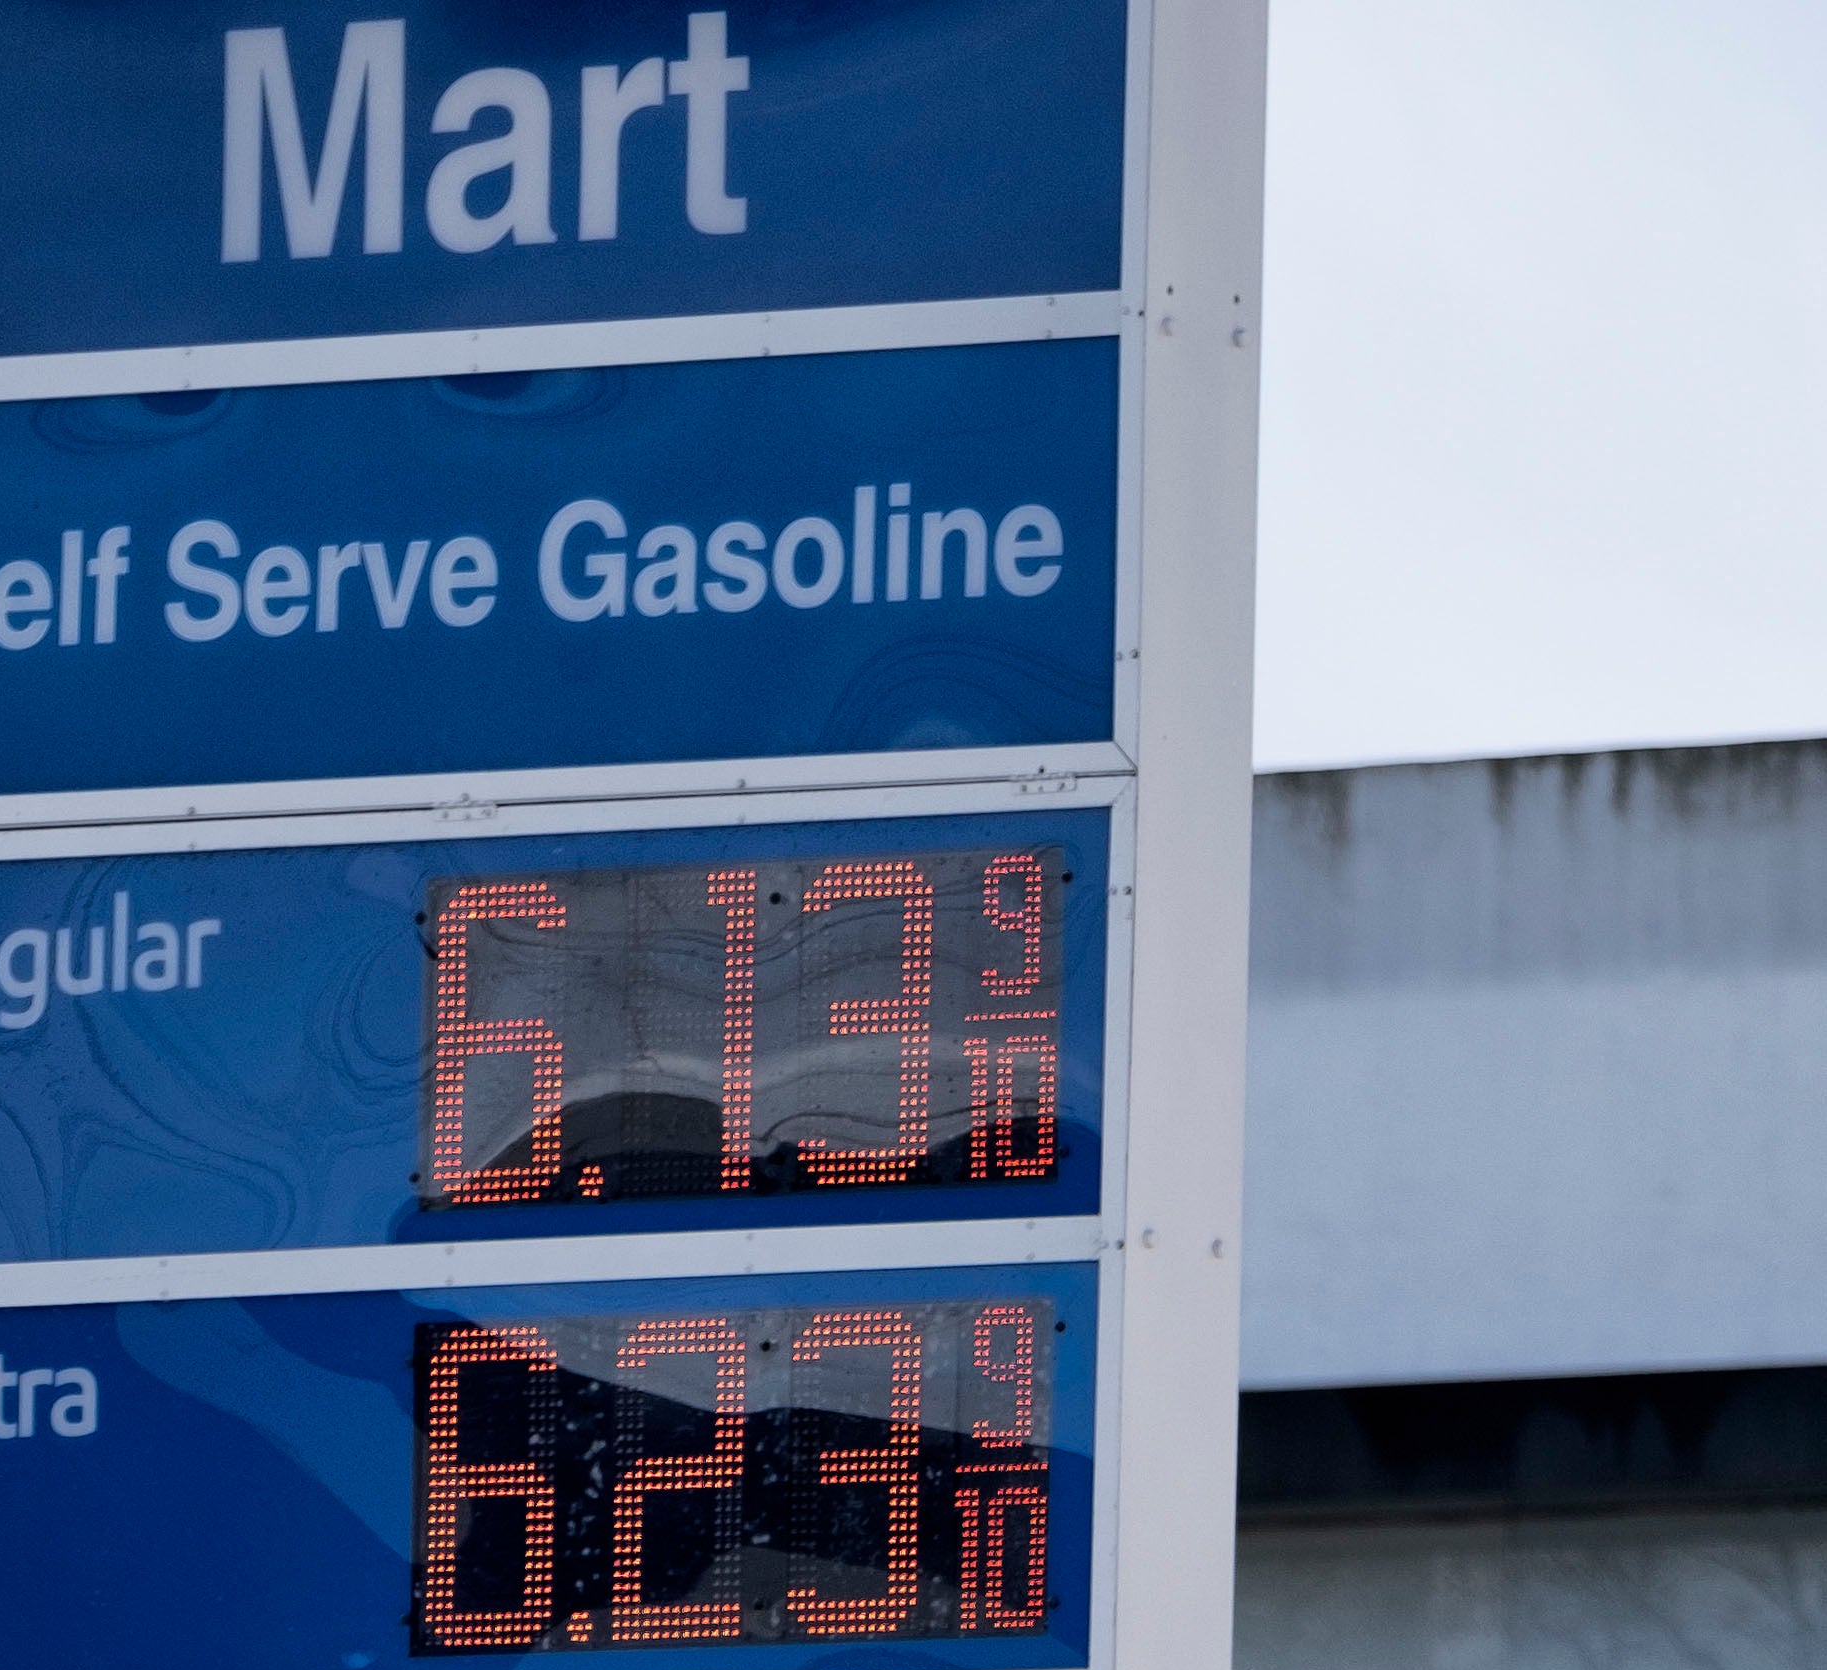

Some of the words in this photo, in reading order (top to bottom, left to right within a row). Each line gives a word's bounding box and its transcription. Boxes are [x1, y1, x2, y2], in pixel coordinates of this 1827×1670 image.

[220, 12, 750, 264] Mart
[163, 520, 499, 642] Serve
[538, 483, 1064, 623] Gasoline
[434, 861, 934, 1203] 6.13
[425, 1311, 921, 1647] 6.23
